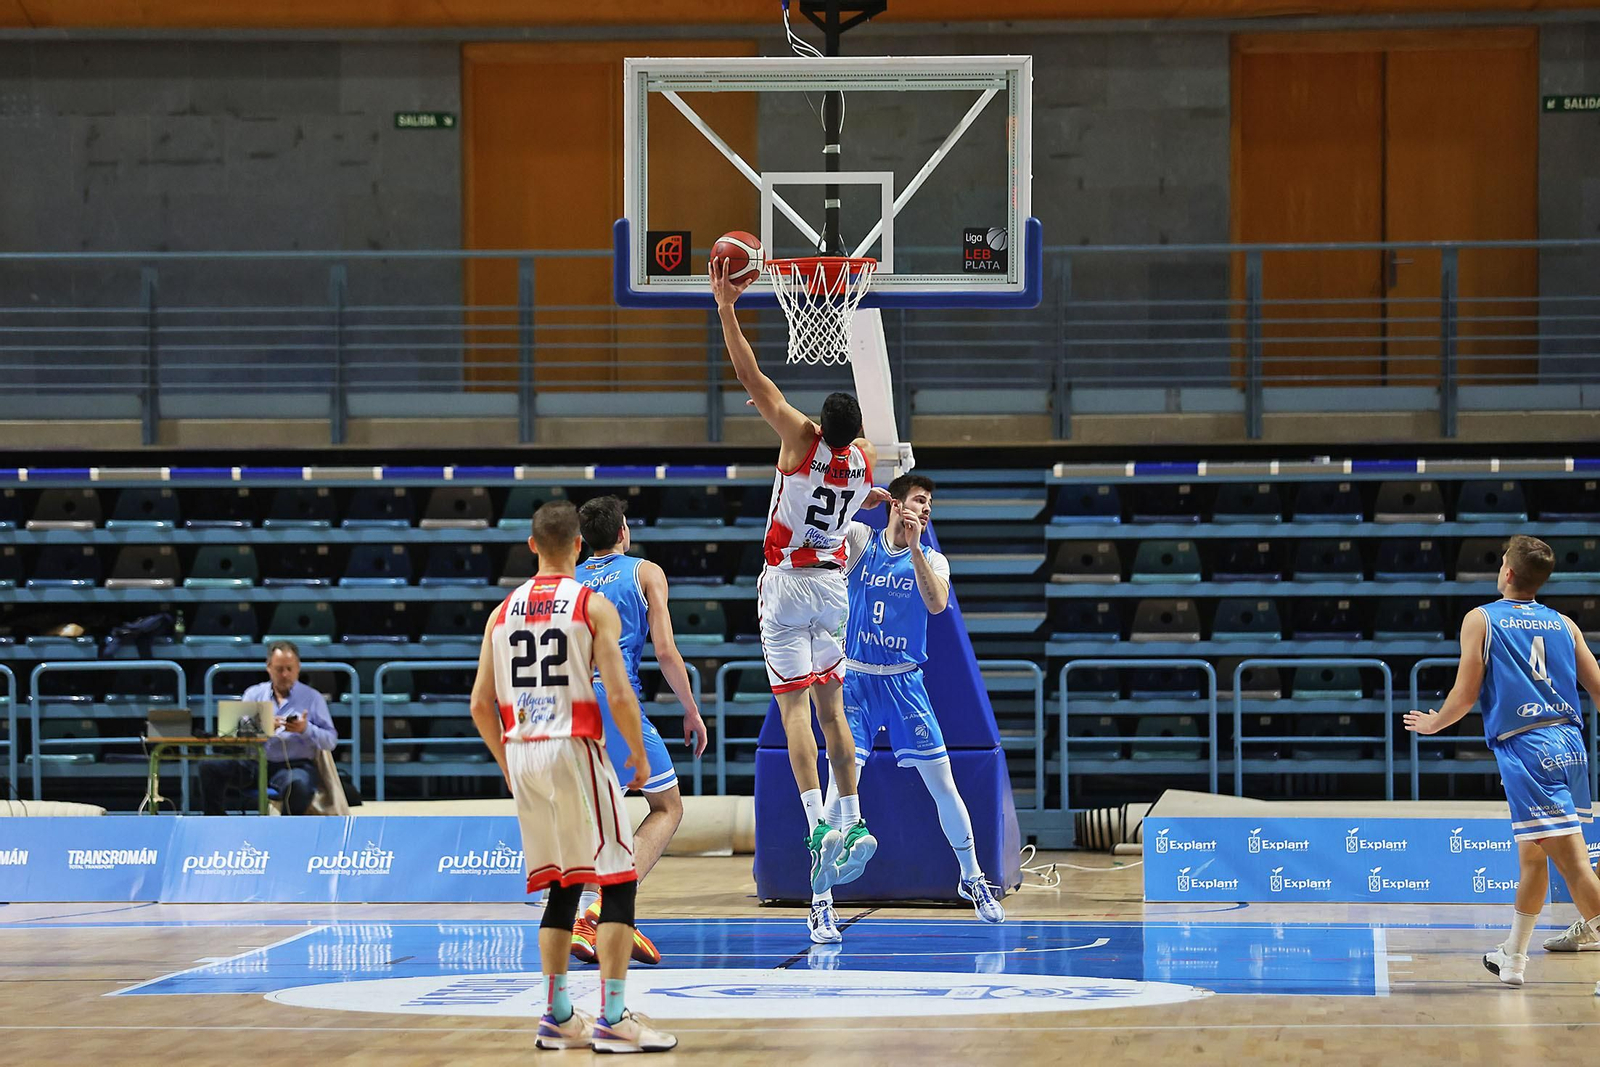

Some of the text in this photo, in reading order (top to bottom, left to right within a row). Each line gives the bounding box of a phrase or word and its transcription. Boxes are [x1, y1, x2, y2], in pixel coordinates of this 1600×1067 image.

[1563, 97, 1600, 109] SALIDA
[965, 232, 983, 244] Liga
[965, 248, 991, 260] LEB
[965, 260, 1001, 270] PLATA
[804, 486, 856, 532] 21
[582, 570, 621, 587] GÓMEZ
[860, 564, 914, 591] huelva
[510, 597, 570, 616] ÁLVAREZ
[872, 600, 885, 624] 9
[1499, 616, 1562, 631] CÁRDENAS
[509, 628, 569, 688] 22
[1528, 635, 1552, 688] 4
[1169, 840, 1217, 851] Explant
[1261, 840, 1310, 851] Explant
[1359, 839, 1408, 851] Explant
[1463, 839, 1512, 851] Explant
[67, 847, 158, 865] TRANSROMÁN
[181, 850, 271, 873] publibit
[307, 850, 395, 873] publibit
[437, 850, 525, 873] publibit
[1190, 878, 1239, 890] Explant
[1283, 878, 1332, 890] Explant
[1382, 878, 1431, 890] Explant
[1487, 879, 1520, 890] Expla
